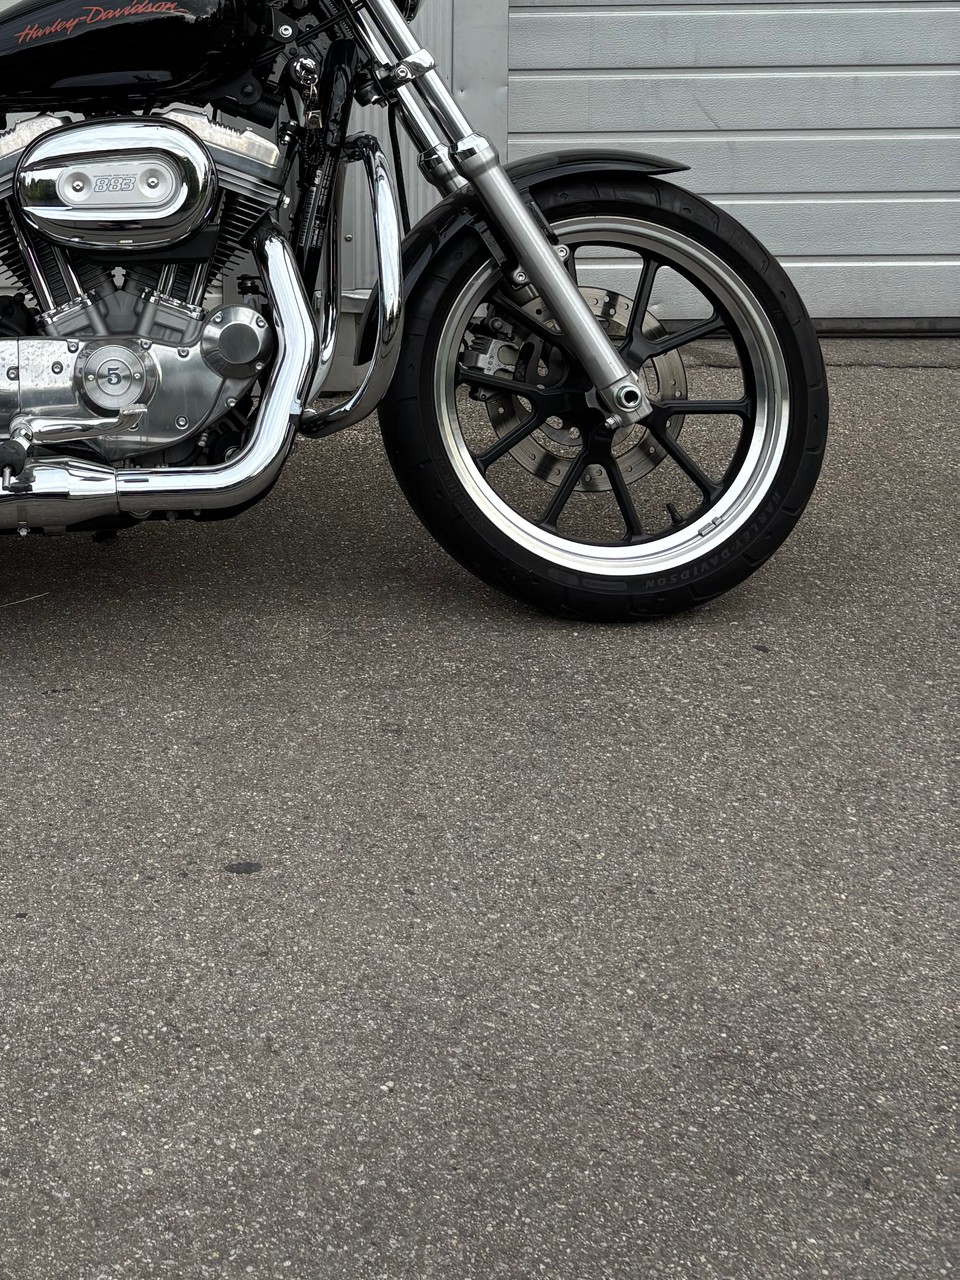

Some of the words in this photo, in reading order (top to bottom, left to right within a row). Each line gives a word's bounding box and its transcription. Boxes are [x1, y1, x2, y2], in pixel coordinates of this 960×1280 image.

[14, 0, 189, 45] Harley-Davidson
[93, 176, 137, 193] 883
[106, 366, 122, 386] 5
[644, 491, 782, 589] HARLEY-DAVIDSON
